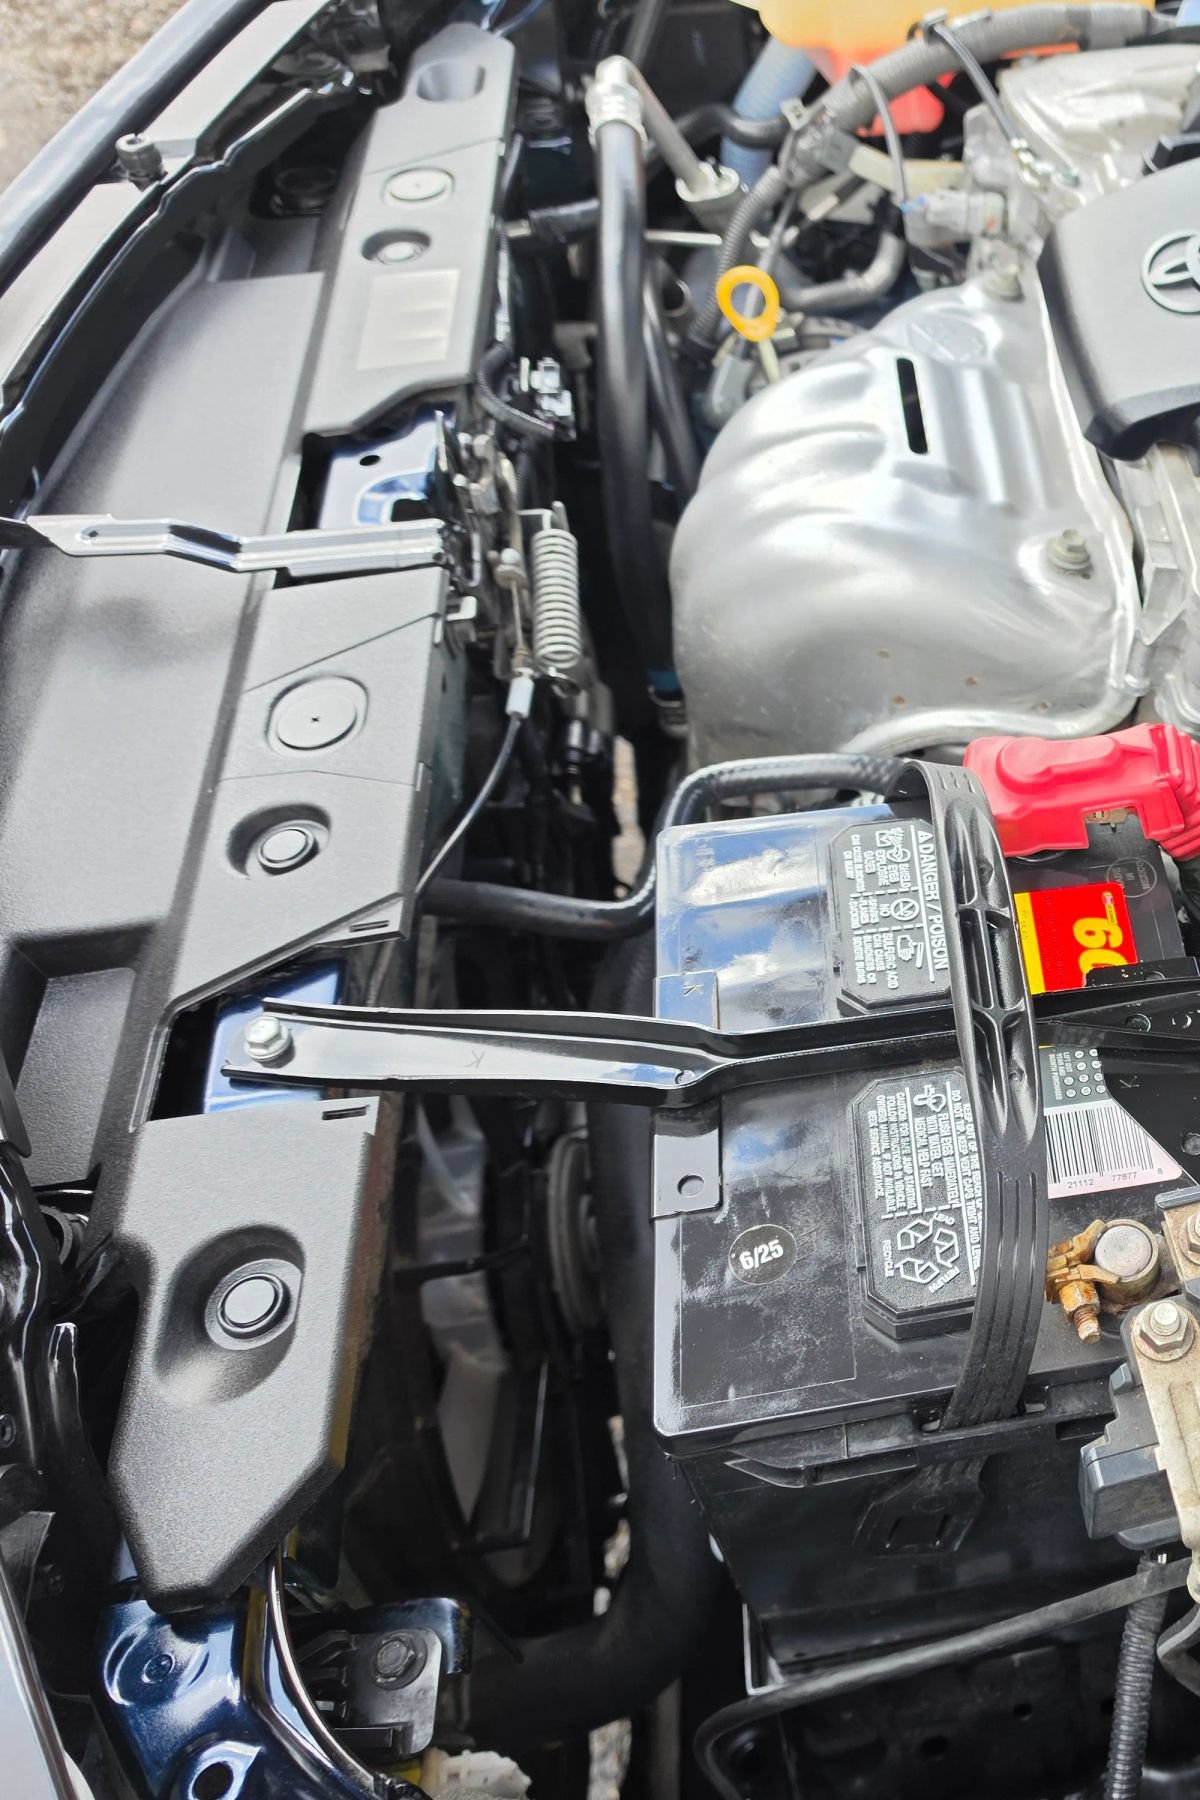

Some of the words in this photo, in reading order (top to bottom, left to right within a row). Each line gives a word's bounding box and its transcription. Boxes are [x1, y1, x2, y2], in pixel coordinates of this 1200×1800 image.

[863, 850, 876, 874] GASES
[876, 850, 889, 887] EXPLOSIVE
[919, 843, 940, 901] DANGER
[888, 864, 899, 883] EYES
[900, 863, 911, 888] SHIELD
[849, 901, 861, 928] SMOKING
[859, 900, 870, 924] FLAMES
[868, 899, 880, 923] SPARKS
[879, 903, 891, 917] NO
[853, 936, 865, 960] SEVERE
[873, 934, 883, 948] CAN
[882, 932, 896, 969] SULFURIC
[928, 914, 949, 970] POISON
[863, 935, 876, 971] BLINDNESS
[874, 949, 886, 971] CAUSE
[855, 961, 867, 984] BURNS
[867, 972, 877, 984] OR
[886, 970, 899, 989] ACID
[1049, 1054, 1058, 1071] MONTH
[1065, 1063, 1073, 1072] OUT
[952, 1090, 962, 1101] DO
[1052, 1072, 1063, 1100] PURCHASED
[868, 1110, 878, 1127] SEEK
[887, 1096, 898, 1122] FOLLOW
[954, 1103, 964, 1119] NOT
[963, 1103, 973, 1122] KEEP
[900, 1122, 908, 1137] FOR
[914, 1117, 928, 1147] MEDICAL
[926, 1115, 939, 1133] WITH
[938, 1113, 951, 1136] FLUSH
[966, 1123, 976, 1139] OUT
[870, 1128, 880, 1155] SERVICE
[890, 1123, 902, 1170] INSTRUCTIONS
[902, 1137, 910, 1154] SAFE
[941, 1137, 954, 1155] EYES
[957, 1135, 968, 1155] KEEP
[968, 1140, 978, 1153] OF
[903, 1155, 913, 1174] JUMP
[918, 1148, 930, 1167] HELP
[960, 1156, 972, 1177] VENT
[970, 1154, 980, 1170] THE
[883, 1162, 893, 1176] NOT
[894, 1171, 902, 1179] IN
[920, 1169, 932, 1188] FAST
[931, 1161, 944, 1177] GET
[944, 1156, 960, 1205] IMMEDIATELY
[963, 1178, 974, 1199] CAPS
[1068, 1178, 1094, 1189] 21112
[1111, 1171, 1137, 1182] 77877
[884, 1177, 896, 1212] AVAILABLE
[895, 1180, 906, 1209] VEHICLE
[904, 1175, 916, 1209] STARTING
[966, 1200, 977, 1224] TIGHT
[969, 1226, 980, 1243] AND
[739, 1239, 783, 1269] 6/25
[882, 1240, 894, 1277] RECYCLE
[928, 1266, 960, 1293] RETURN
